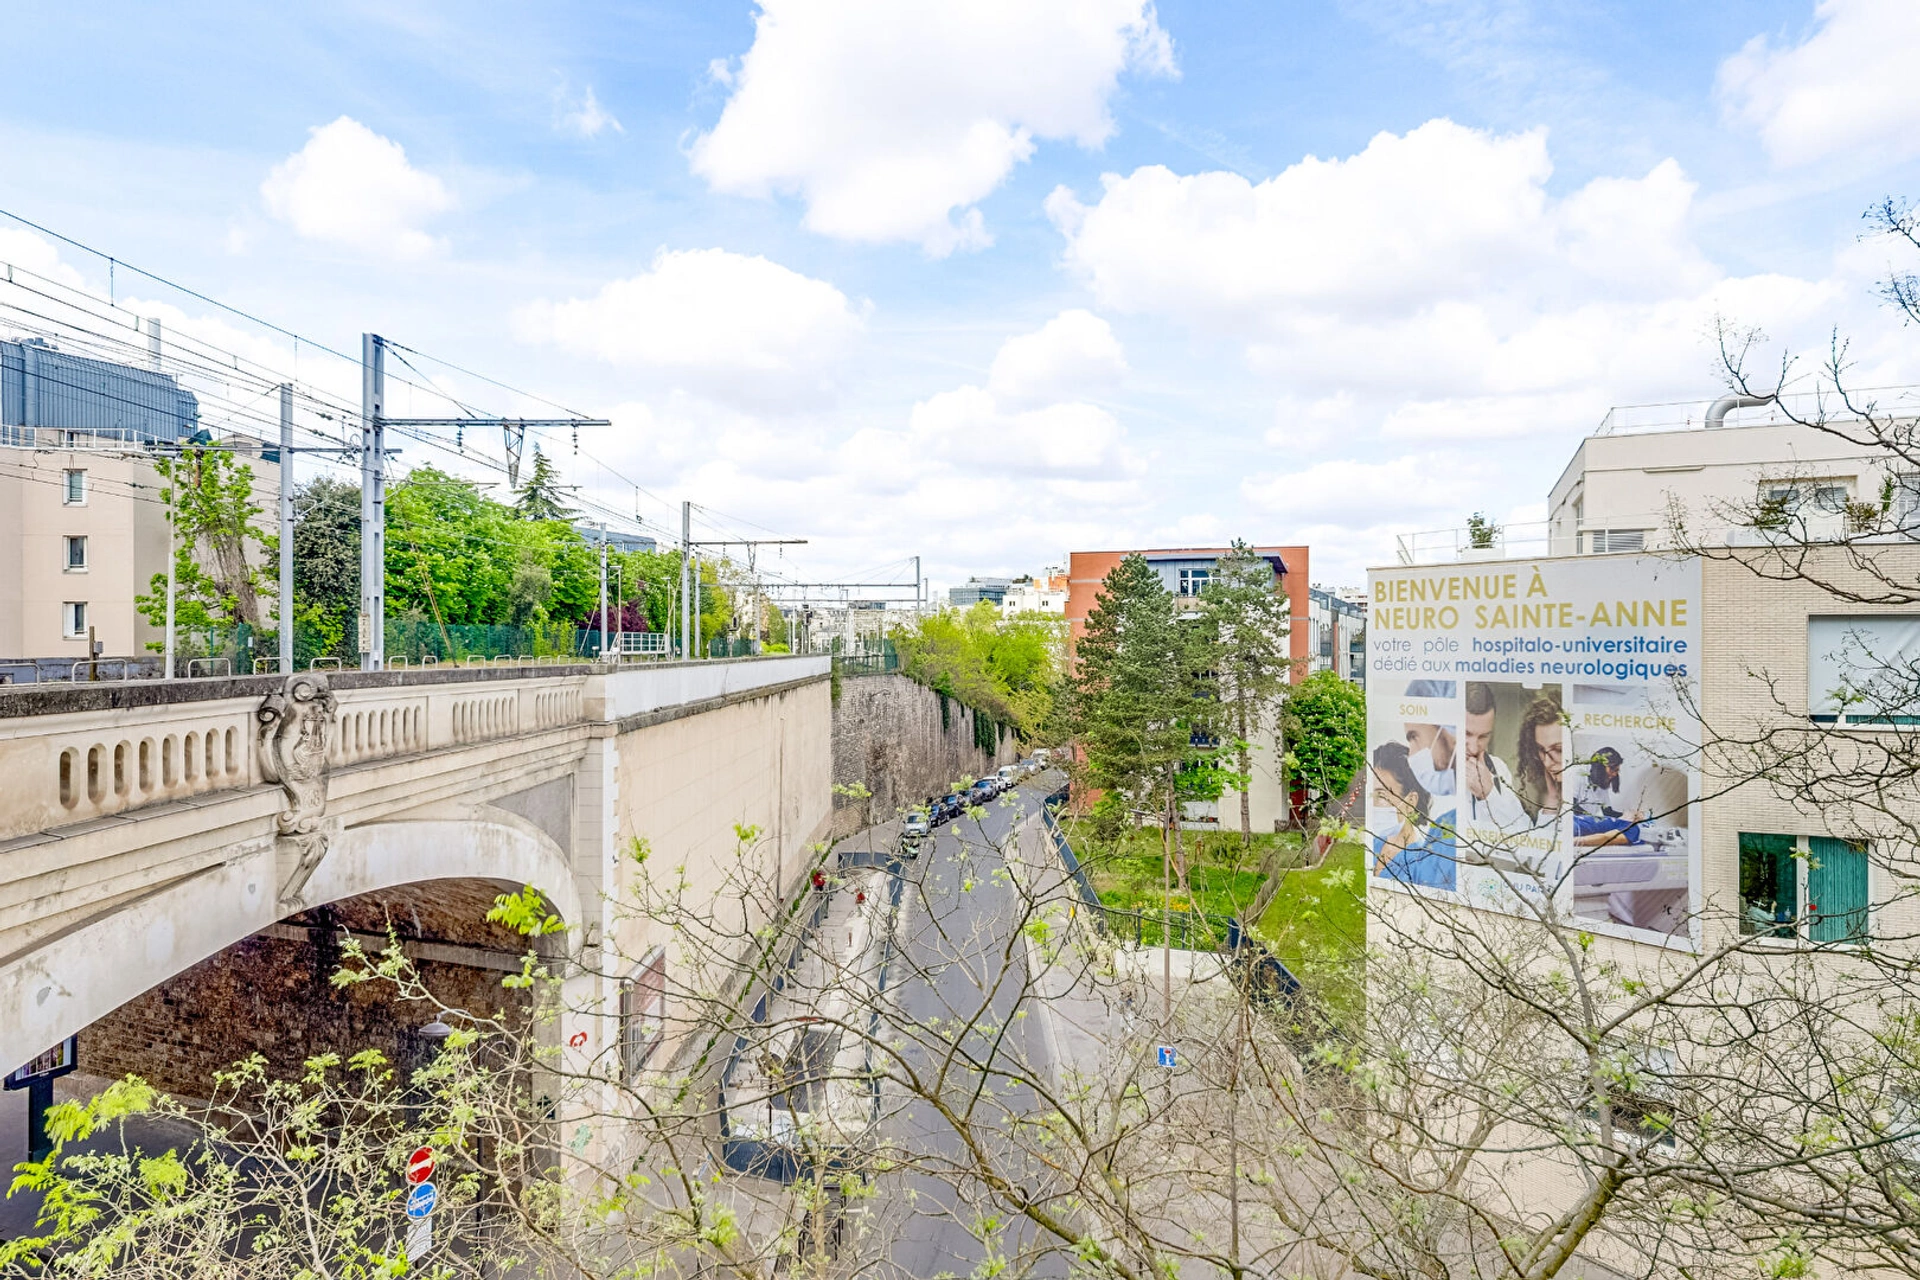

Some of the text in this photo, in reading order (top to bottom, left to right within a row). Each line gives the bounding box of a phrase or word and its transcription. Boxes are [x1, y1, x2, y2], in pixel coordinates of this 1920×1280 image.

[1374, 565, 1548, 603] BIENVENUE À
[1374, 599, 1687, 630] NEURO SAINTE-ANNE
[1373, 636, 1688, 656] votre pôle hospitalo-universitaire
[1373, 655, 1688, 680] dédié aux maladies neurologiques
[1399, 704, 1428, 716] SOIN
[1584, 713, 1676, 731] RECHERCHE
